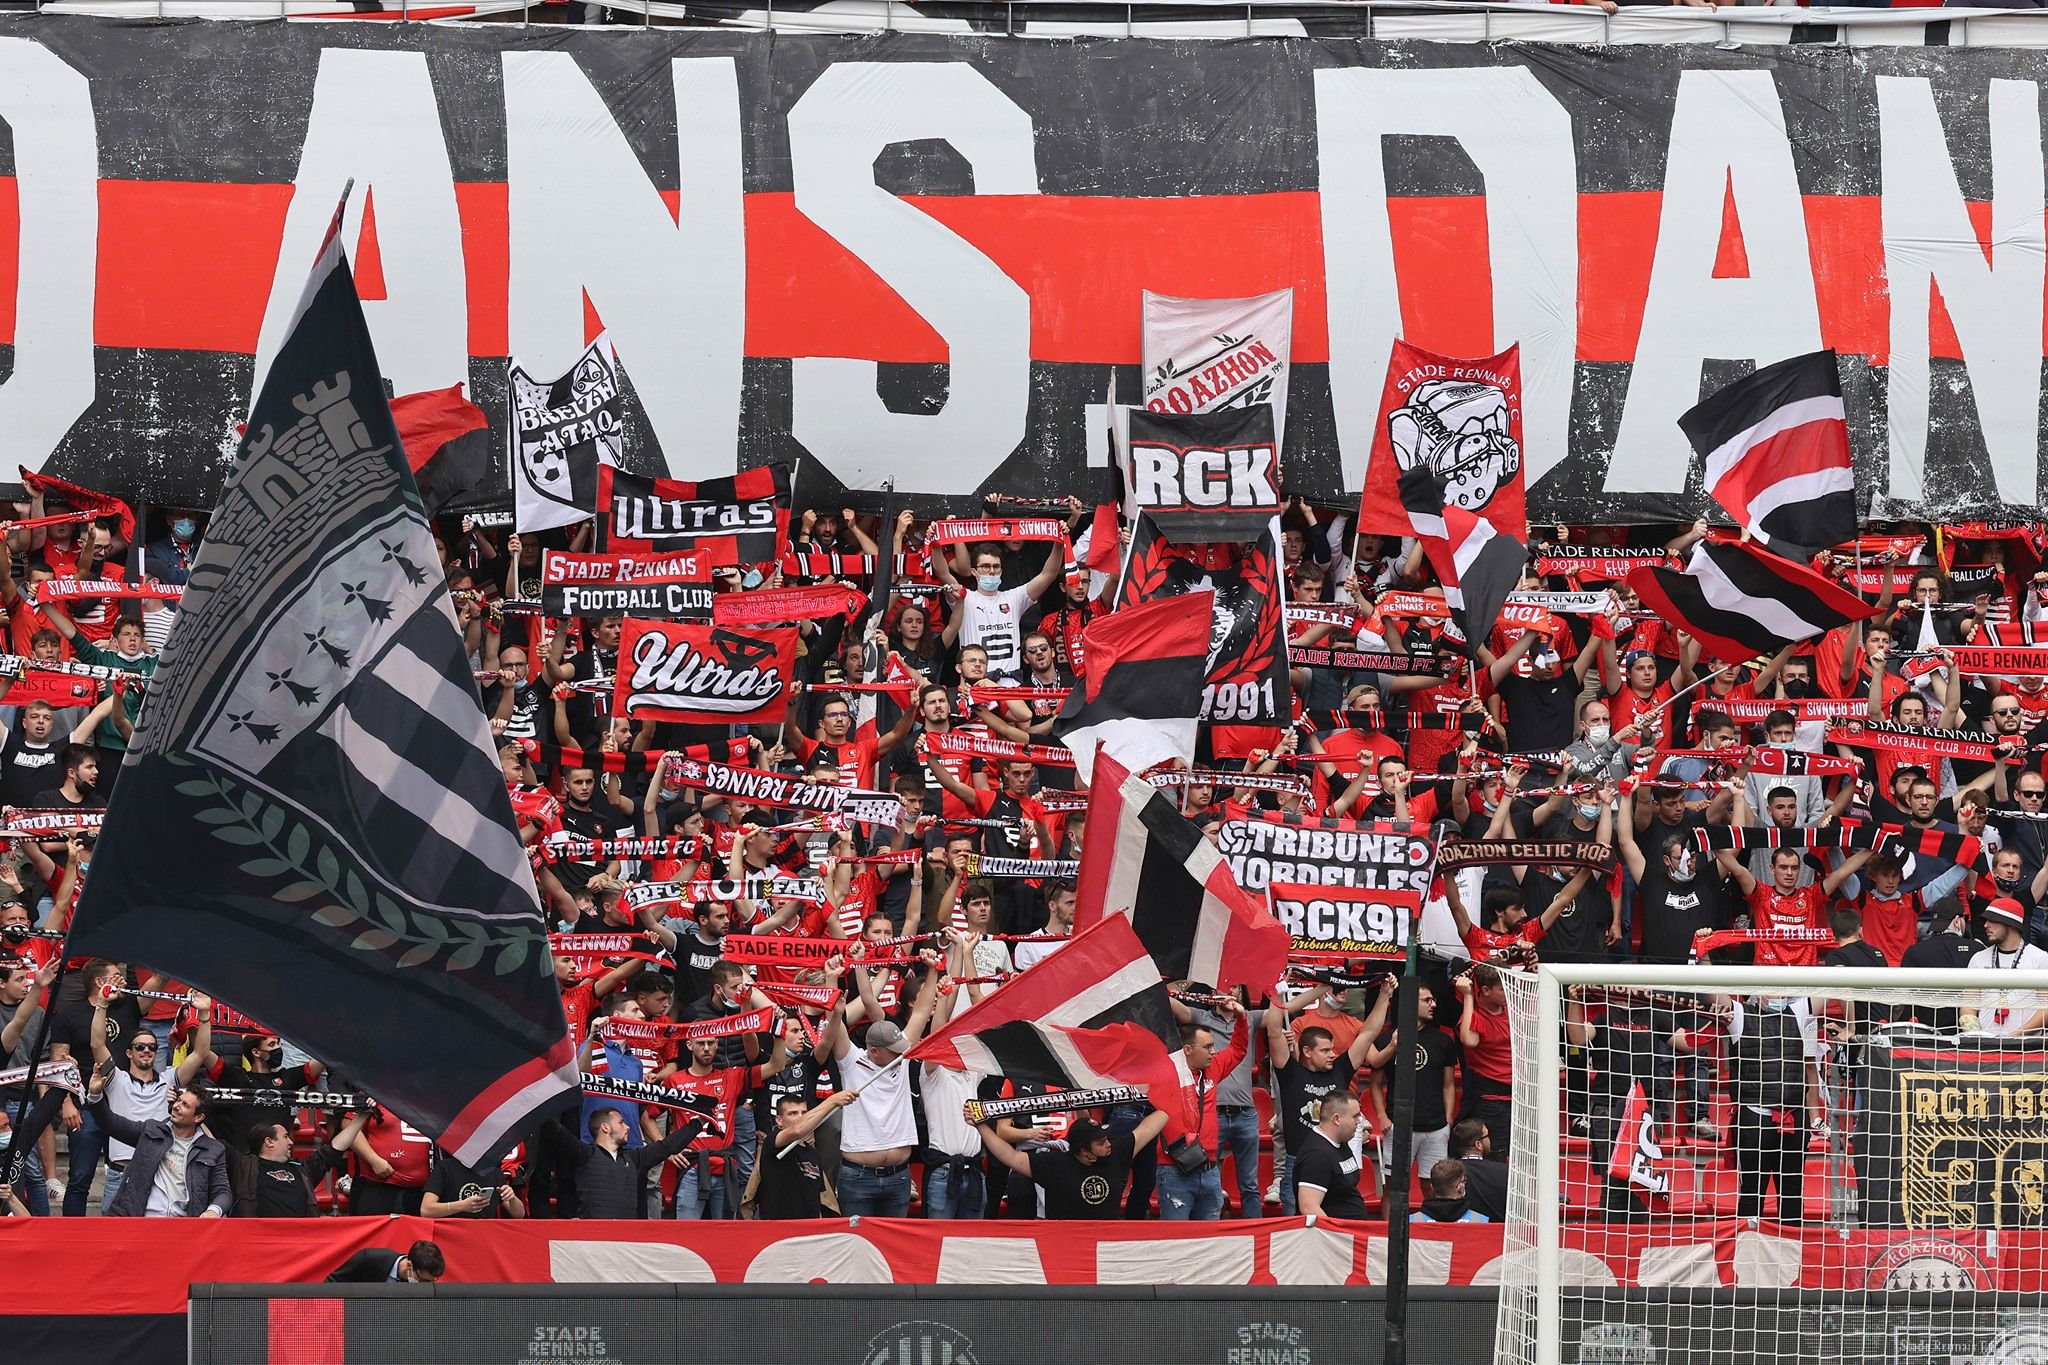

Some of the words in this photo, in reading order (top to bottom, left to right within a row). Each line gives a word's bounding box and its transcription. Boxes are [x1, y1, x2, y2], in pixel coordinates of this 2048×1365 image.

[1397, 364, 1446, 393] STADE
[1453, 367, 1512, 390] RENNAIS
[519, 381, 618, 432] BREIZH
[541, 410, 613, 455] ATAO
[1132, 447, 1277, 506] RCK
[613, 495, 776, 538] Ultras
[941, 521, 990, 537] FOOTBALL
[1019, 520, 1059, 536] RENNAIS
[1547, 545, 1585, 558] TADE
[1591, 546, 1665, 558] RENNAIS
[1605, 560, 1630, 570] CLUB
[47, 580, 80, 596] STADE
[81, 580, 123, 594] RENNAIS
[788, 595, 838, 614] STADE
[1383, 603, 1424, 612] RENNAIS
[1425, 603, 1438, 611] FC
[1394, 595, 1424, 603] STADE
[716, 600, 785, 619] RENNAIS
[631, 630, 783, 698] Ultras
[1289, 648, 1330, 666] TADE
[1333, 651, 1409, 671] RENNAIS
[1411, 657, 1435, 672] FC
[1199, 677, 1276, 721] 1991
[1808, 701, 1847, 716] RENNAIS
[1850, 702, 1869, 716] ADE
[1730, 702, 1776, 717] FOOTBALL
[1868, 719, 1919, 735] STADE
[1923, 726, 1995, 744] RENNAIS
[940, 733, 970, 752] STADE
[973, 737, 1016, 756] RENNAIS
[1877, 734, 1928, 750] FOOTBALL
[1934, 741, 1959, 754] CLUB
[1964, 745, 1987, 756] 1901
[1769, 777, 1794, 787] NIKE
[548, 841, 594, 859] STADE
[601, 839, 670, 856] RENNAIS
[672, 840, 696, 854] FC
[1246, 821, 1408, 865] TRIBUNE
[1437, 843, 1507, 865] ROAZHON
[1511, 843, 1572, 858] CELTIC
[1576, 844, 1611, 862] KOP
[982, 856, 1057, 876] ROAZHON
[772, 880, 827, 905] FANS
[561, 935, 632, 952] RENNAIS
[1782, 928, 1828, 940] RENNES
[726, 939, 778, 956] STADE
[1290, 936, 1338, 951] Tribune
[1340, 937, 1398, 954] Mordelles
[602, 1024, 616, 1037] DE
[686, 1020, 733, 1039] FOOTBALL
[735, 1014, 760, 1031] CLUB
[295, 1090, 356, 1109] 1991
[580, 1083, 631, 1097] FOOTBALL
[635, 1091, 660, 1102] CLUB
[611, 1077, 699, 1104] RENNAIS
[1887, 1241, 1968, 1265] ROAZHON
[533, 1325, 602, 1342] STADE
[1237, 1322, 1303, 1346] STADE
